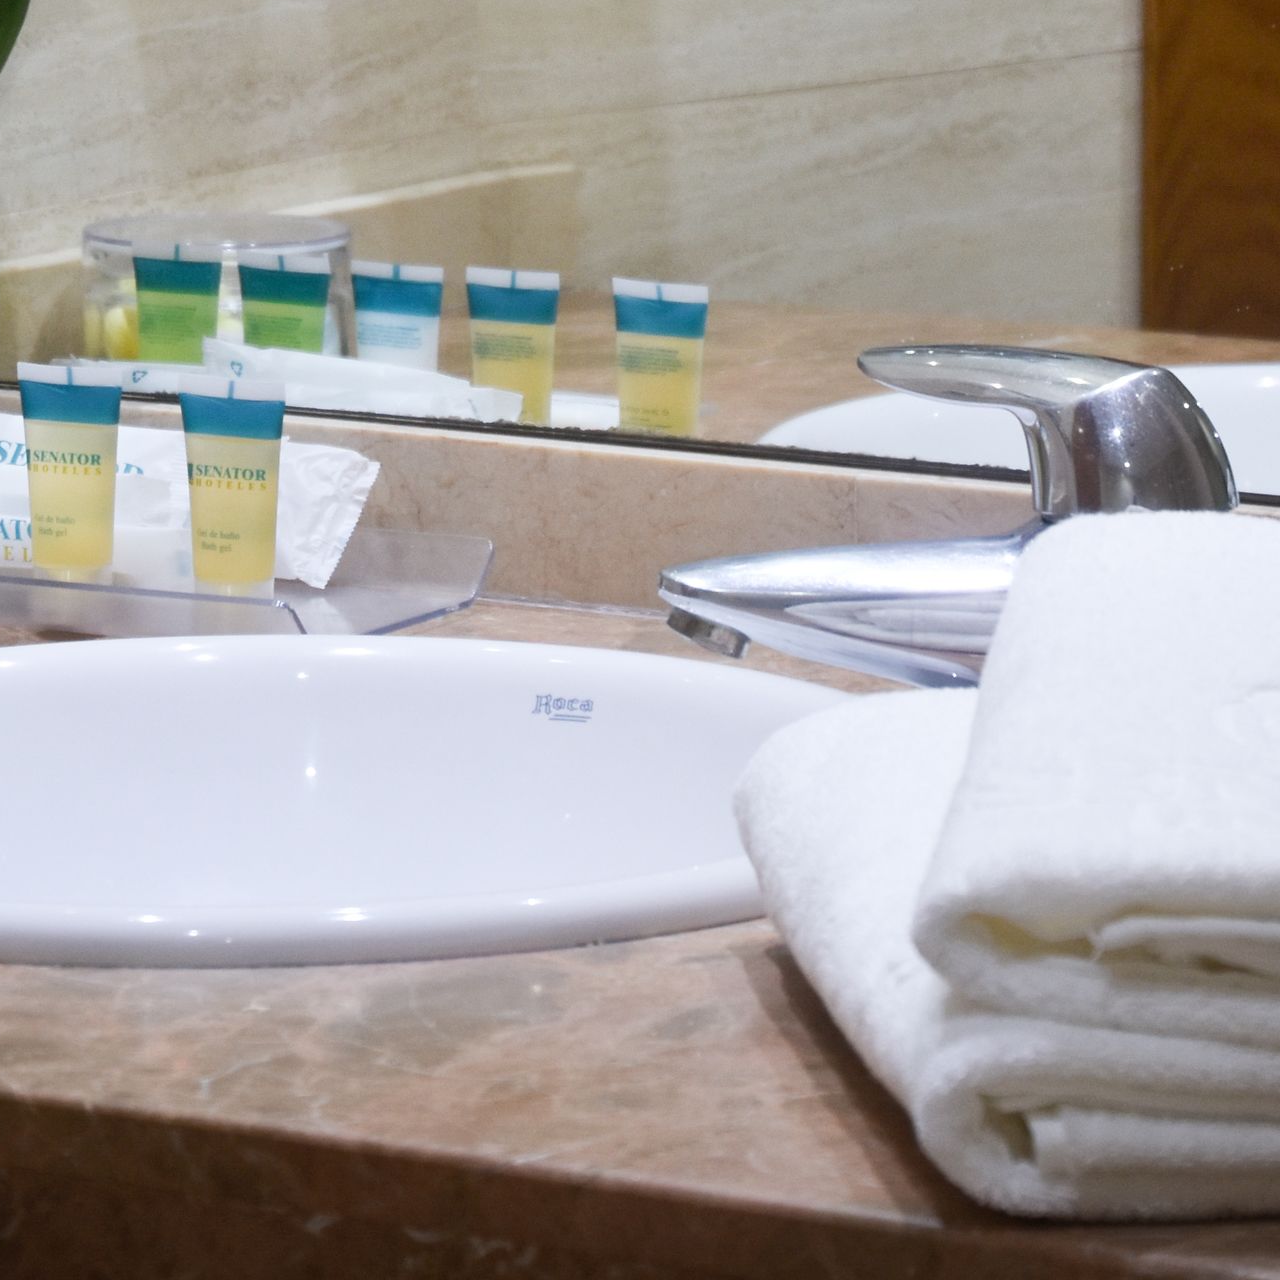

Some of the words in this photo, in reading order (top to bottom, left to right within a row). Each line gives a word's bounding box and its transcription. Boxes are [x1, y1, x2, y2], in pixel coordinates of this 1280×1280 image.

[33, 450, 102, 466] SENATOR
[32, 463, 103, 476] HOTELES
[196, 463, 267, 481] SENATOR
[195, 477, 268, 491] HOTELES
[531, 693, 594, 715] Roca
